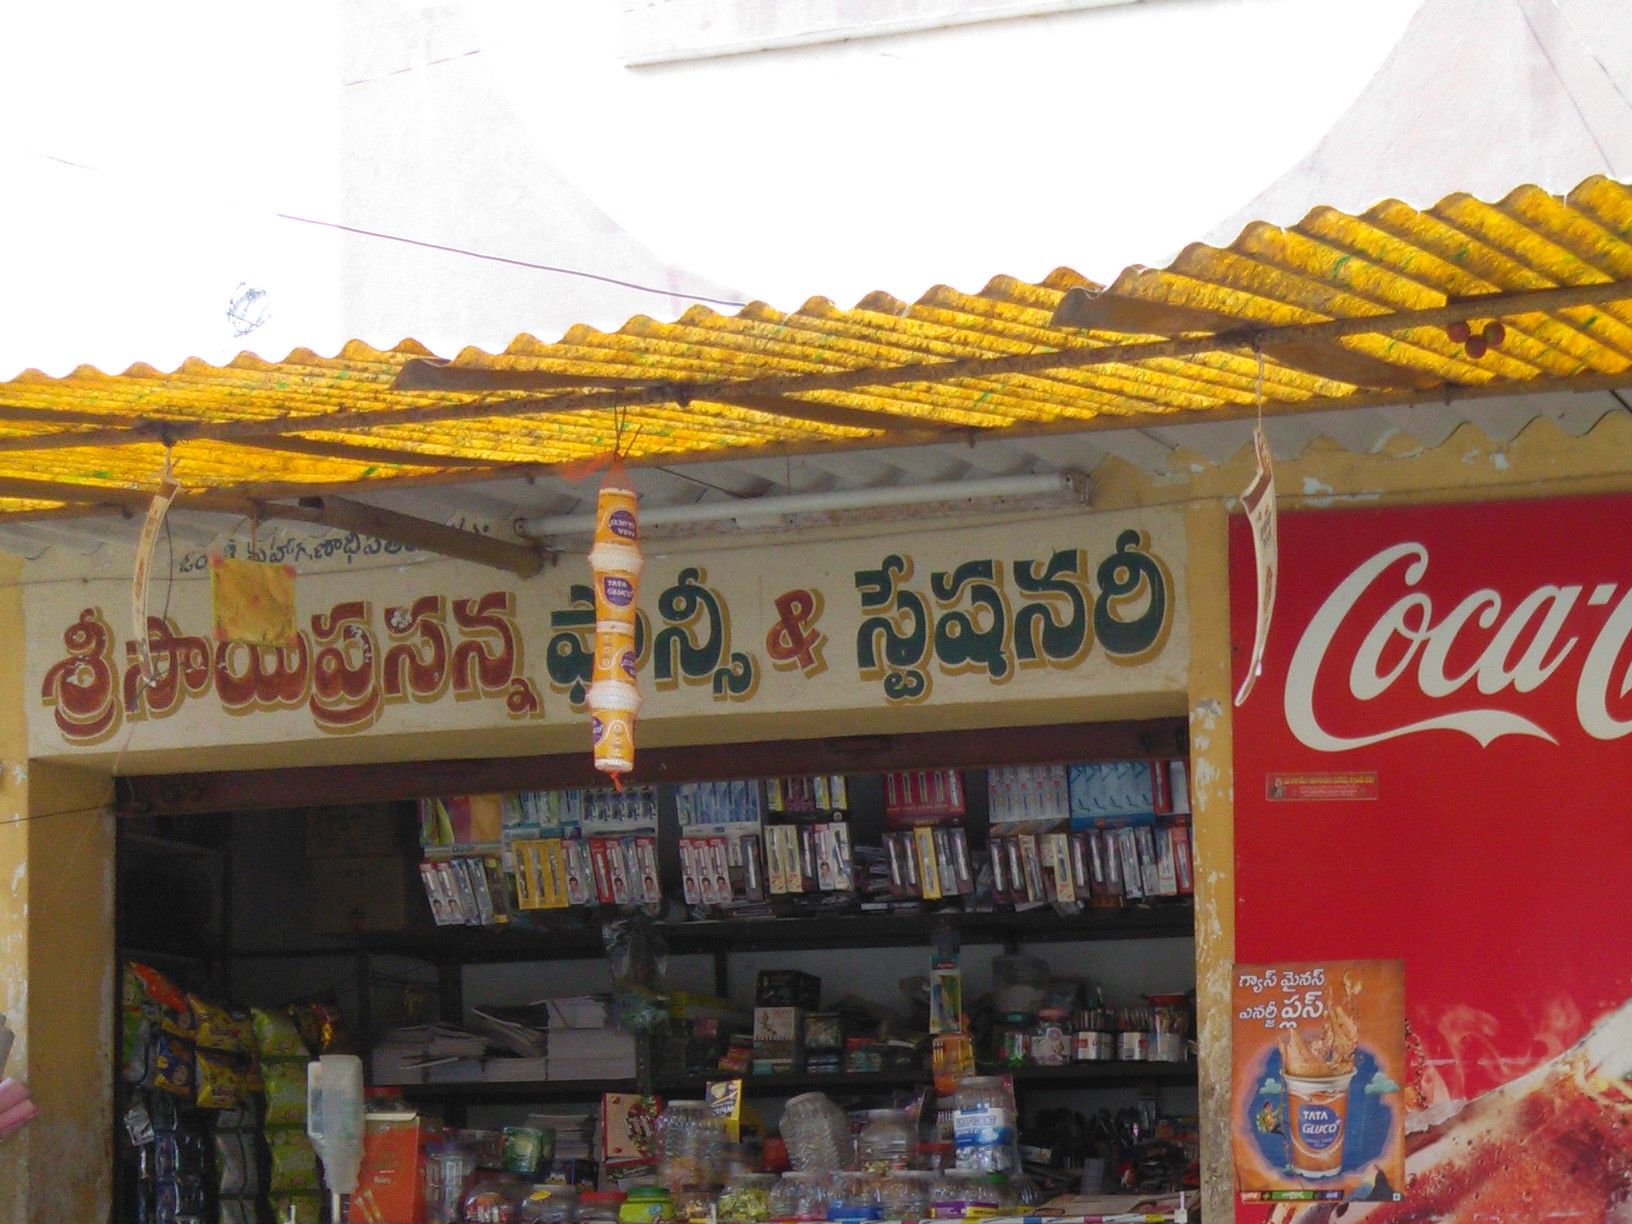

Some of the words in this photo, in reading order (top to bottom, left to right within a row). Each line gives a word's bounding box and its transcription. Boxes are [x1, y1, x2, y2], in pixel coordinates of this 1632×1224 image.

[607, 580, 628, 588] TATA
[766, 588, 820, 668] &
[1302, 1110, 1329, 1121] TATA
